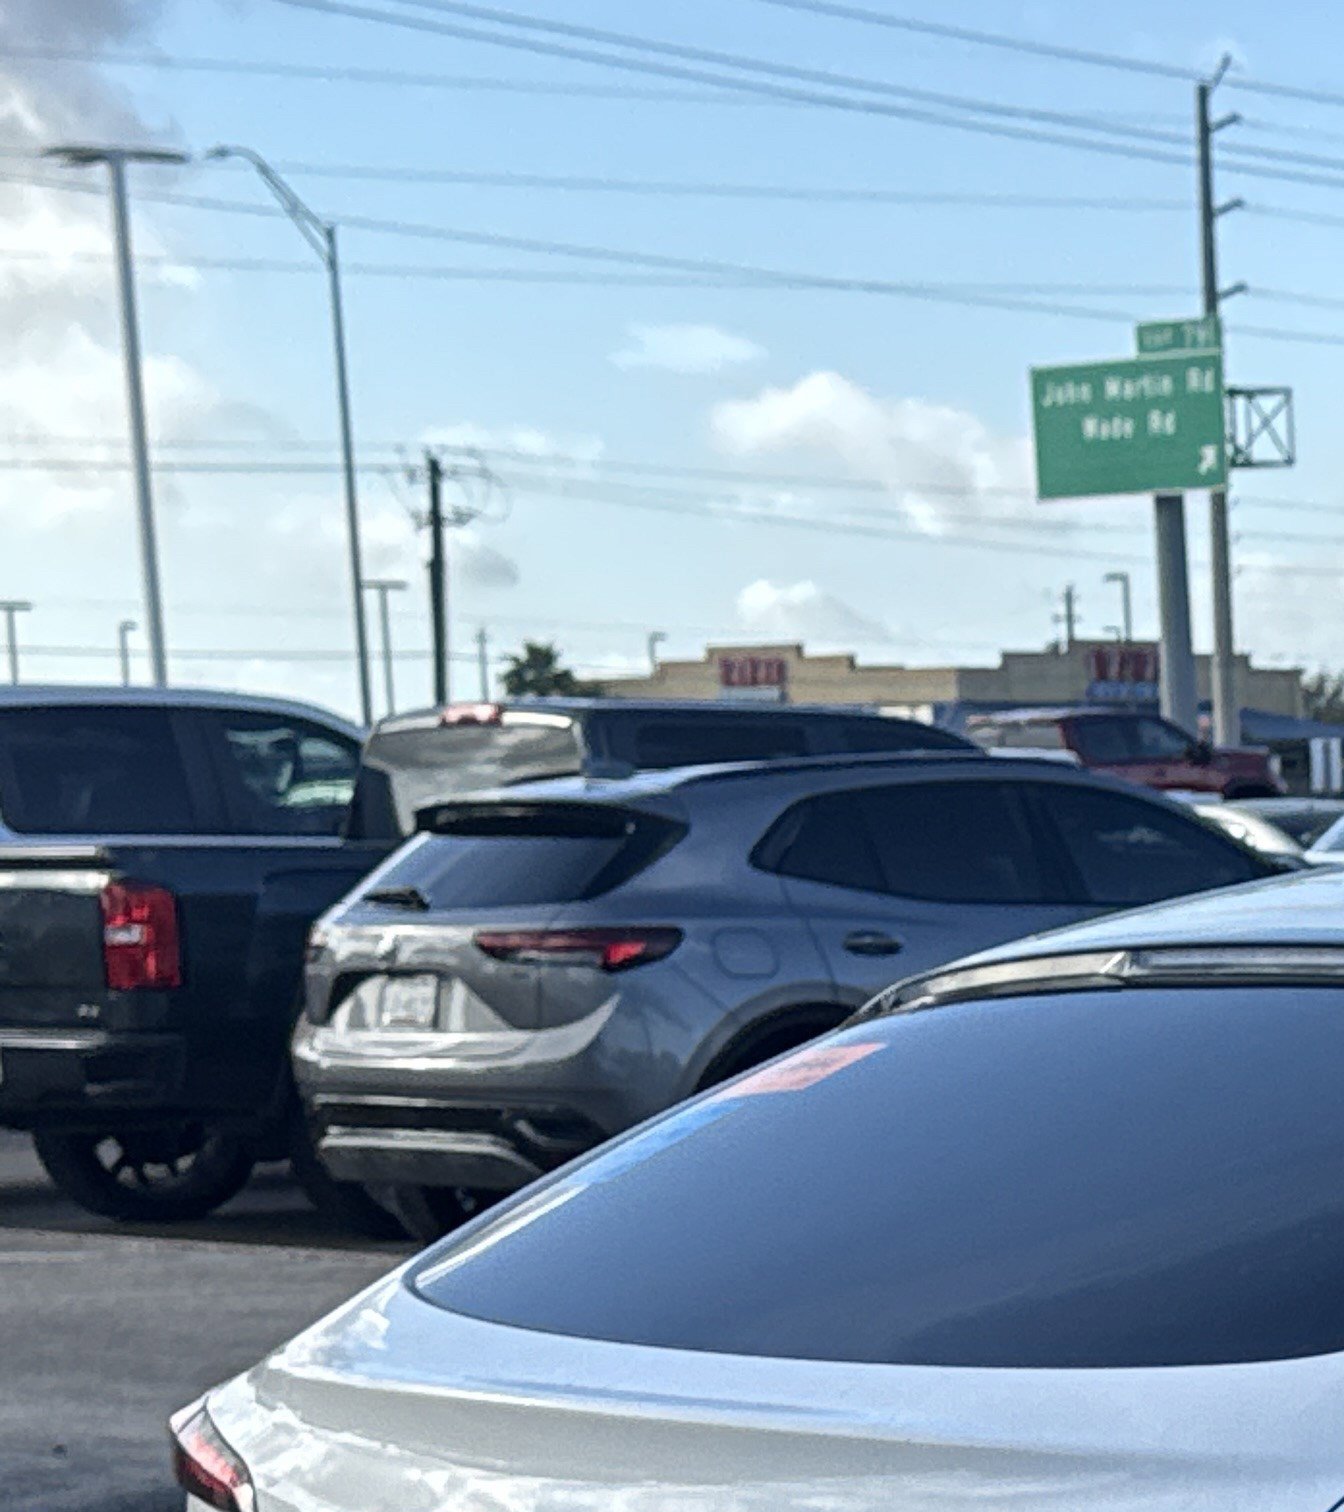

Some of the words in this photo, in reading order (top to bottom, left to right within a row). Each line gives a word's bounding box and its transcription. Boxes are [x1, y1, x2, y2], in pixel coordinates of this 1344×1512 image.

[1042, 379, 1093, 407] John
[1104, 374, 1173, 402] Martin
[1185, 366, 1216, 394] Rd
[1082, 415, 1135, 442] Wade
[1147, 408, 1176, 437] Rd
